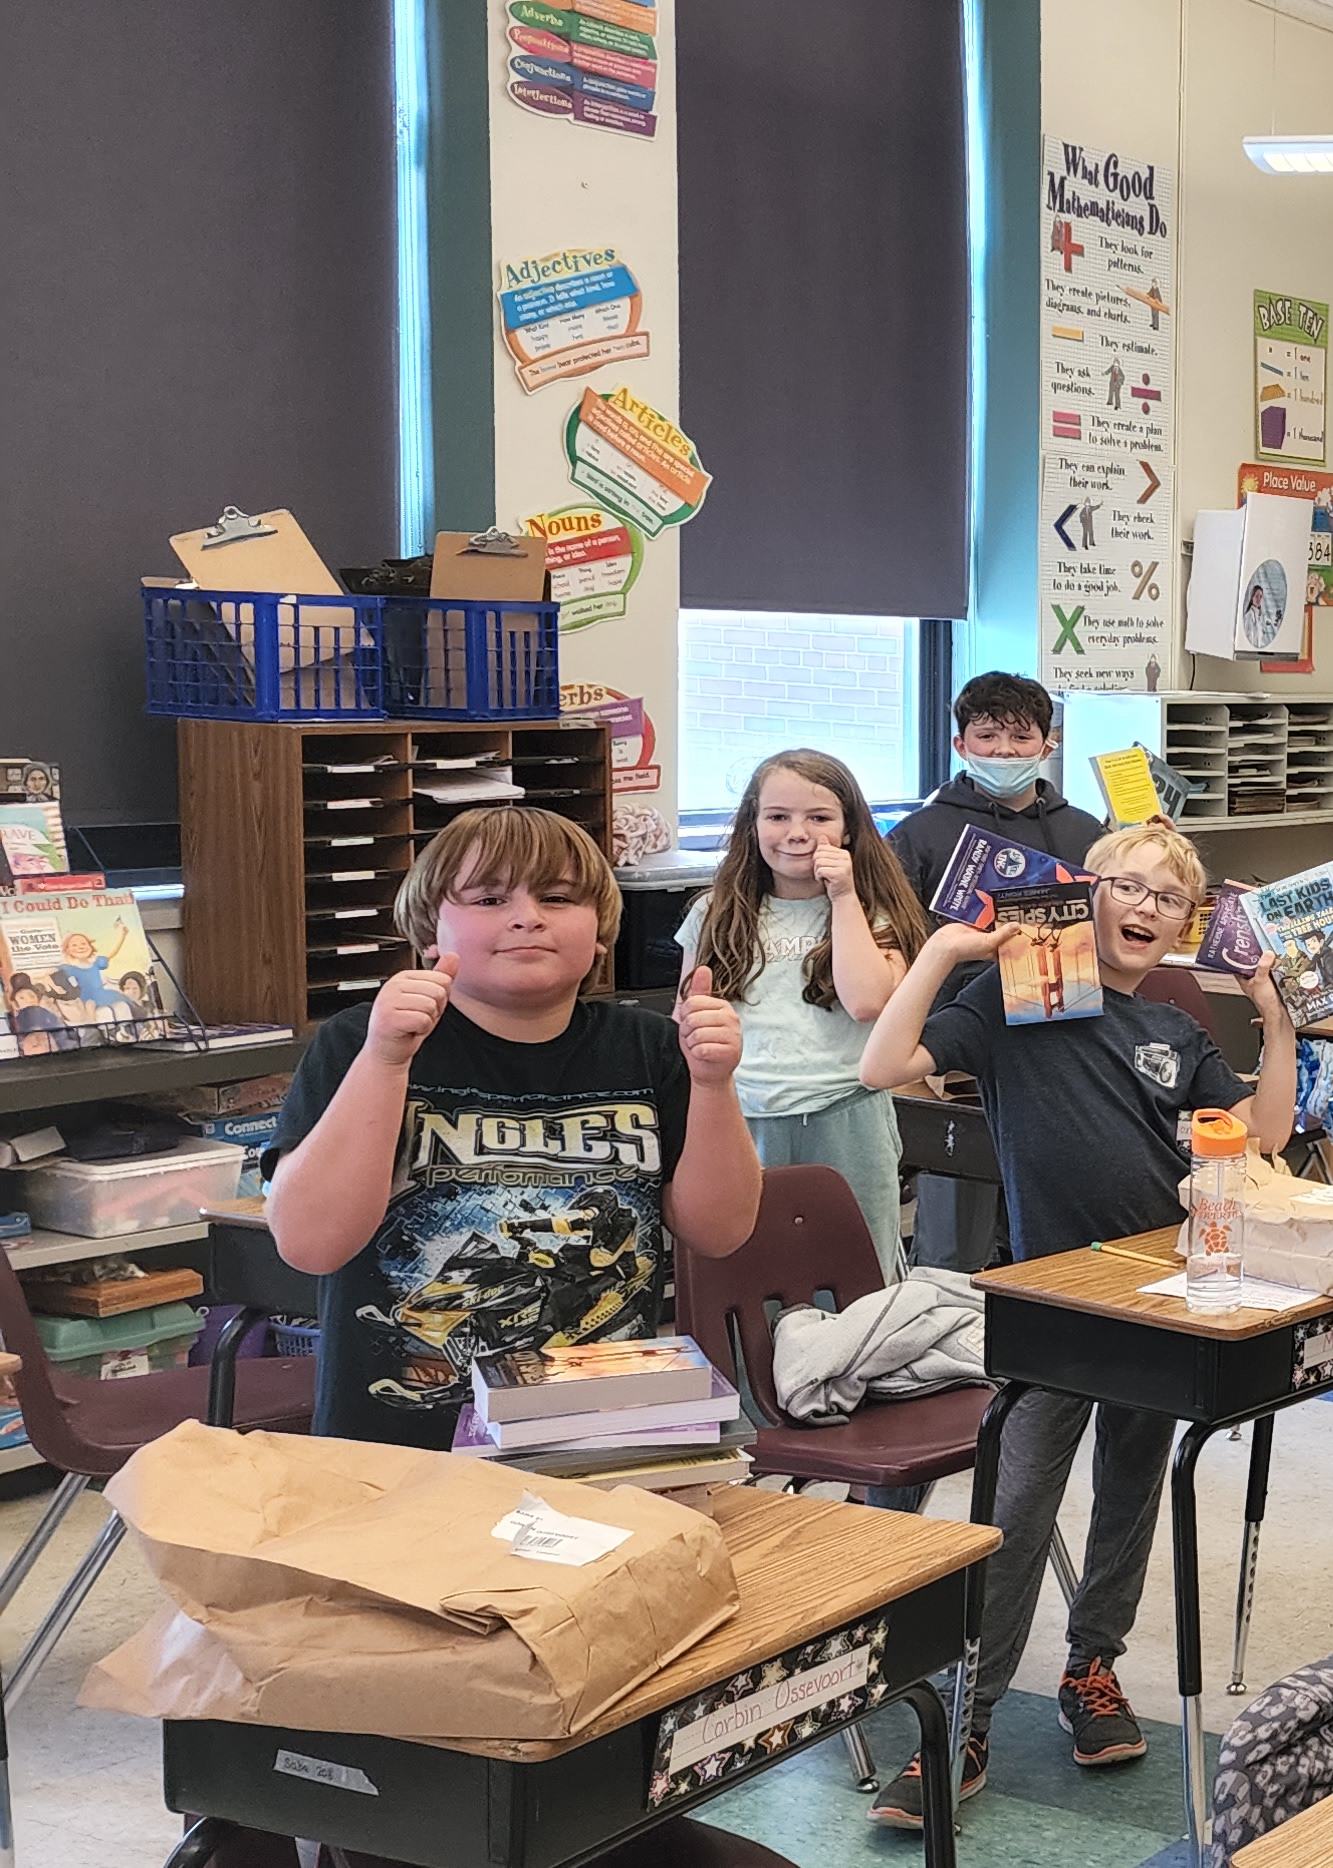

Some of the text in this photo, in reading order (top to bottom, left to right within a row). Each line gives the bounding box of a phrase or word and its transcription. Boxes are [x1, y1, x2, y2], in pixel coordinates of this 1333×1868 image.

[1062, 141, 1155, 201] What Good
[1046, 171, 1168, 237] Mathematicians Do
[1099, 236, 1154, 261] They look for
[505, 249, 615, 289] Adjectives
[1108, 260, 1144, 276] patterns.
[1046, 279, 1065, 300] They
[1258, 296, 1324, 344] BASE TEN
[1099, 334, 1158, 356] They estimate.
[1056, 361, 1091, 379] They ask
[1051, 382, 1095, 396] questions.
[614, 387, 690, 456] Articles
[1090, 415, 1110, 433] They
[1058, 457, 1078, 475] They
[1070, 476, 1089, 489] their
[1263, 472, 1316, 492] Place Value
[525, 512, 602, 540] Nouns
[1112, 510, 1130, 526] They
[1111, 527, 1130, 540] their
[1308, 542, 1331, 562] 384
[1053, 666, 1072, 682] They
[14, 896, 88, 913] Could Do
[1260, 878, 1332, 912] LAST KIDS
[996, 904, 1089, 924] CITY SPIES
[1267, 911, 1282, 922] ON
[8, 932, 57, 946] WOMEN
[1306, 996, 1328, 1012] MAX
[224, 1116, 278, 1136] Connect
[1200, 1197, 1236, 1210] Beach
[702, 1654, 856, 1744] Corbin Ossevoort
